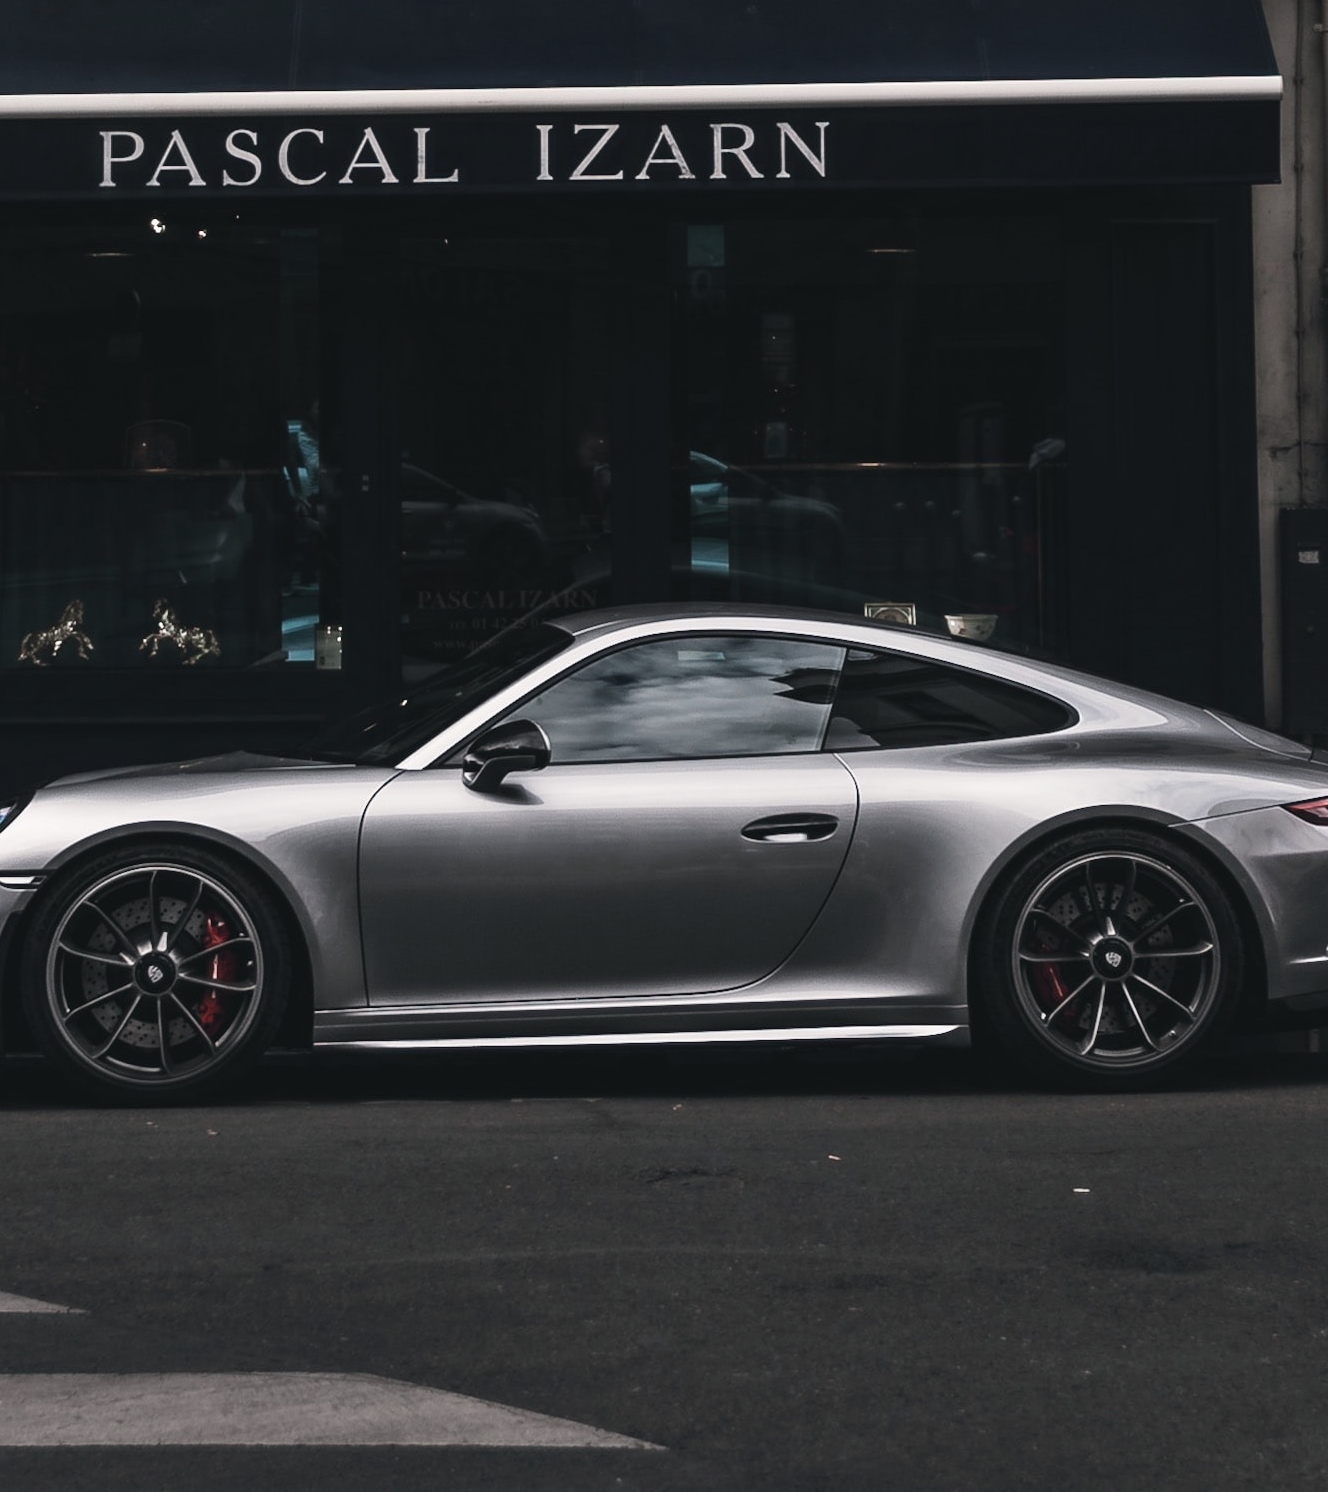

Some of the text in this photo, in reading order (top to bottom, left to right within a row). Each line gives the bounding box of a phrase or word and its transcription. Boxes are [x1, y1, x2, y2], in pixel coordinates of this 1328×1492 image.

[98, 120, 831, 188] PASCAL IZARN
[417, 590, 598, 609] PASCAL IZARN
